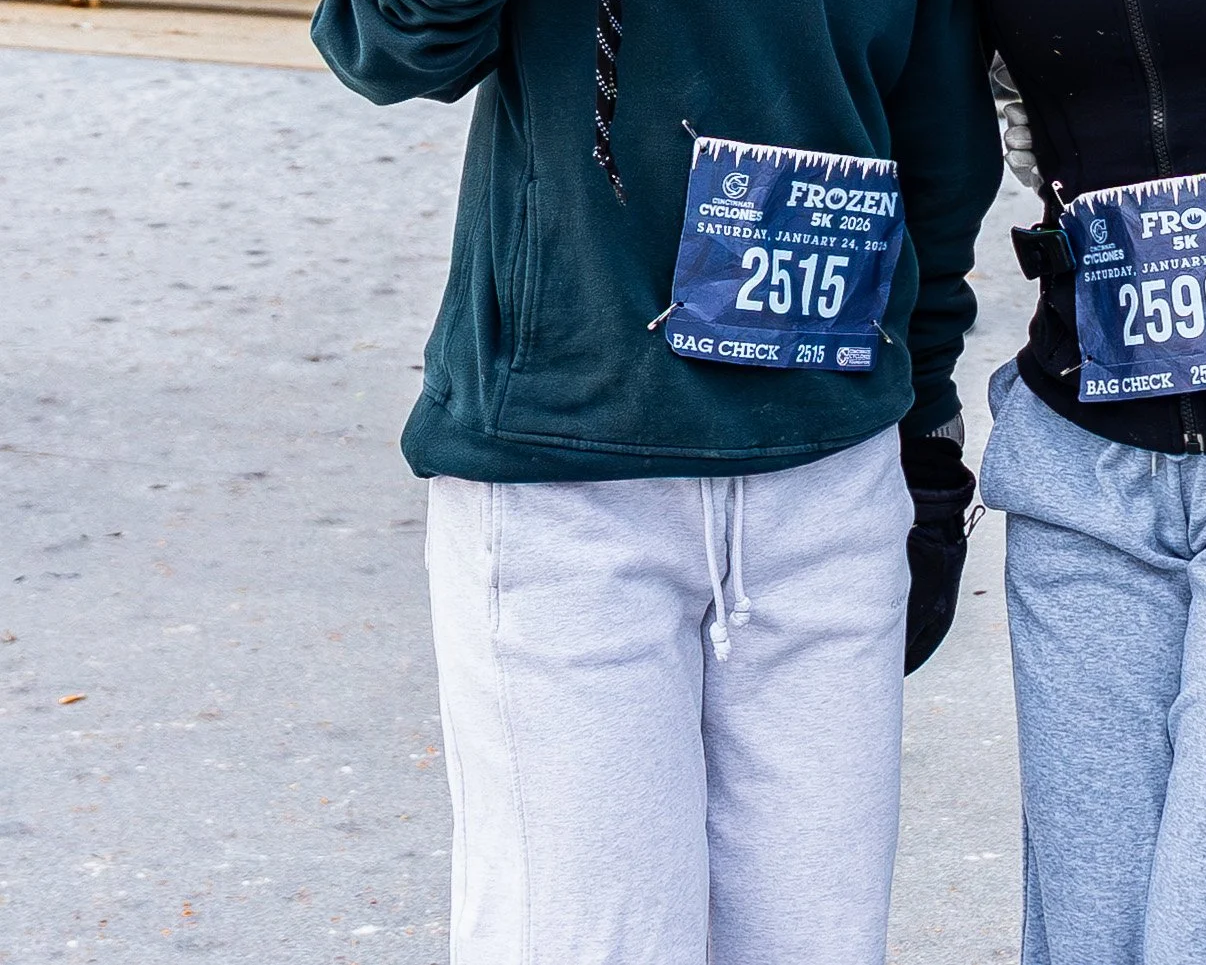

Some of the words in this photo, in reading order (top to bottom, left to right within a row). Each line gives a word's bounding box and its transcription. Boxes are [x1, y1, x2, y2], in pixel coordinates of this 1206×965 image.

[786, 180, 899, 218] FROZEN
[699, 203, 764, 222] CYCLONES
[810, 213, 834, 229] 5K
[838, 215, 872, 233] 2026
[696, 222, 771, 241] SATURDAY,
[774, 230, 837, 248] JANUARY
[841, 238, 859, 250] 24,
[1172, 234, 1199, 251] 5K
[1083, 248, 1125, 266] CYCLONES
[735, 246, 850, 319] 2515
[1084, 265, 1138, 283] SATURDAY,
[673, 332, 714, 354] BAG
[717, 340, 781, 361] CHECK
[796, 344, 826, 364] 2515
[1085, 379, 1119, 396] BAG
[1122, 372, 1175, 394] CHECK
